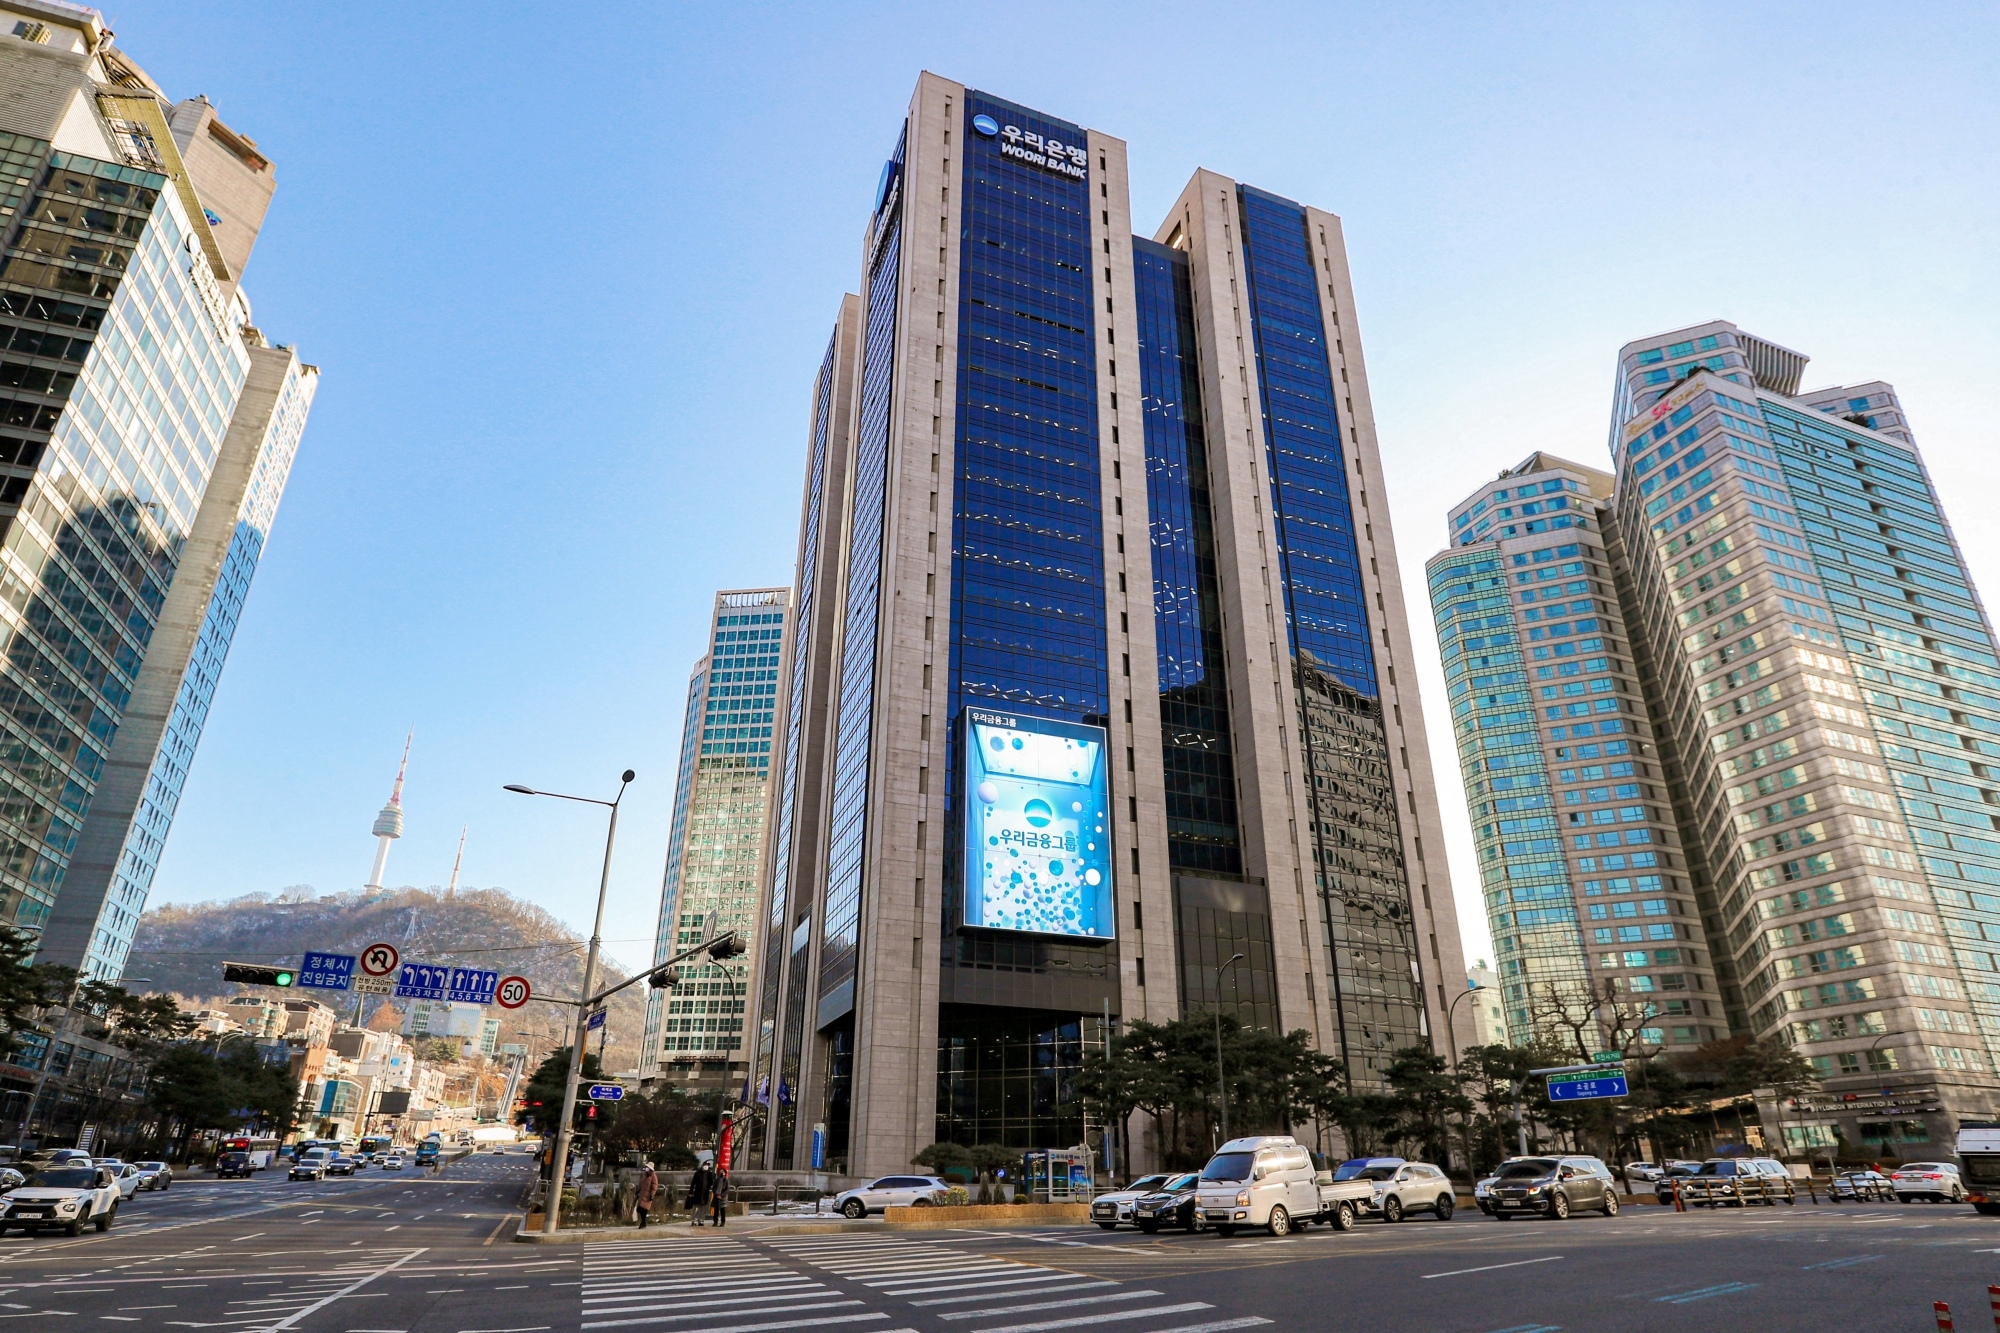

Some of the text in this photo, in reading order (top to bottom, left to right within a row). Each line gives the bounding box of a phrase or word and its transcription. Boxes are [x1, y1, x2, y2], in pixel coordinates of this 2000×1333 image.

[1001, 124, 1087, 166] 우리은행
[1001, 142, 1087, 179] WOORI BANK
[1651, 398, 1673, 420] SK
[972, 712, 1017, 728] 우리금융그룹
[999, 828, 1077, 852] 우리금융그룹
[310, 956, 349, 972] 정체시
[302, 971, 349, 987] 진입금지
[371, 978, 392, 986] 250m
[398, 987, 441, 998] 1,2,3 차로
[449, 992, 491, 1002] 4,5,6 차로
[503, 984, 523, 1001] 50
[1576, 1082, 1597, 1090] 소공로
